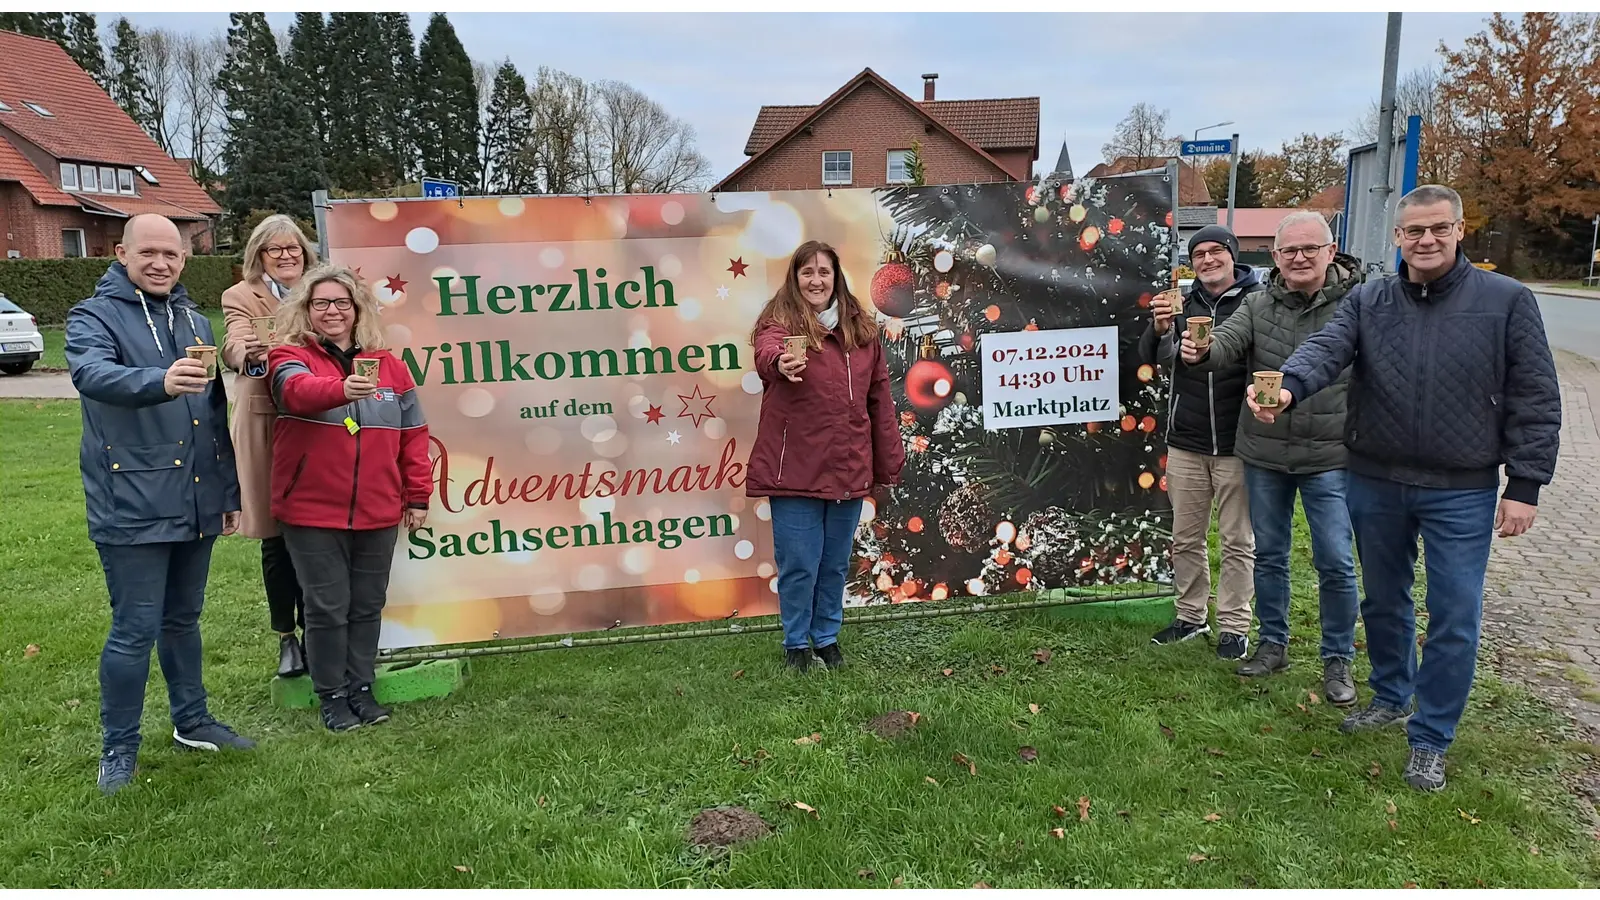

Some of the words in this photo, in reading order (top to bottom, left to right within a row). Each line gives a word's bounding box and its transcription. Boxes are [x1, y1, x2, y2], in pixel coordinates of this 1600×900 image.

[1187, 143, 1225, 153] Domäne
[433, 266, 678, 316] Herzlich
[992, 343, 1108, 365] 07.12.2024
[998, 371, 1056, 390] 14:30
[1062, 365, 1104, 382] Uhr
[519, 399, 560, 419] auf
[564, 398, 613, 417] dem
[993, 396, 1110, 418] Marktplatz
[429, 436, 748, 514] Adventsmark
[408, 512, 736, 560] Sachsenhagen
